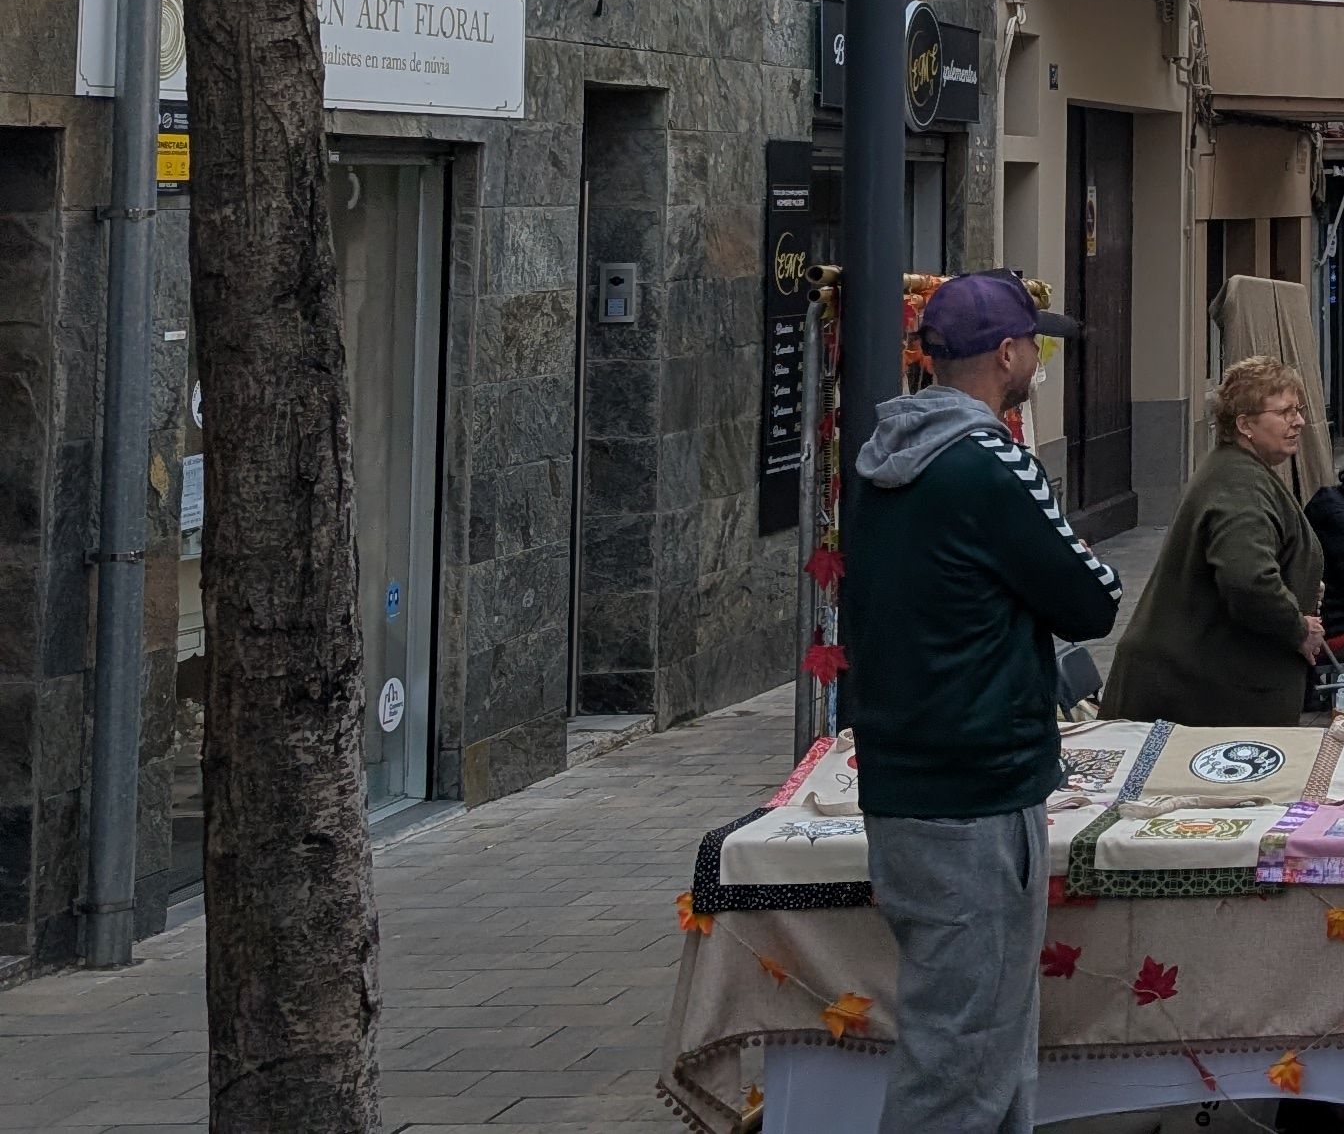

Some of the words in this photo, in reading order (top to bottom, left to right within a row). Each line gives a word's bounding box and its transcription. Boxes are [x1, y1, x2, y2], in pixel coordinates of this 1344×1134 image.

[414, 2, 495, 44] FLORAL
[365, 54, 378, 69] en
[382, 55, 407, 71] rams
[409, 52, 422, 72] de
